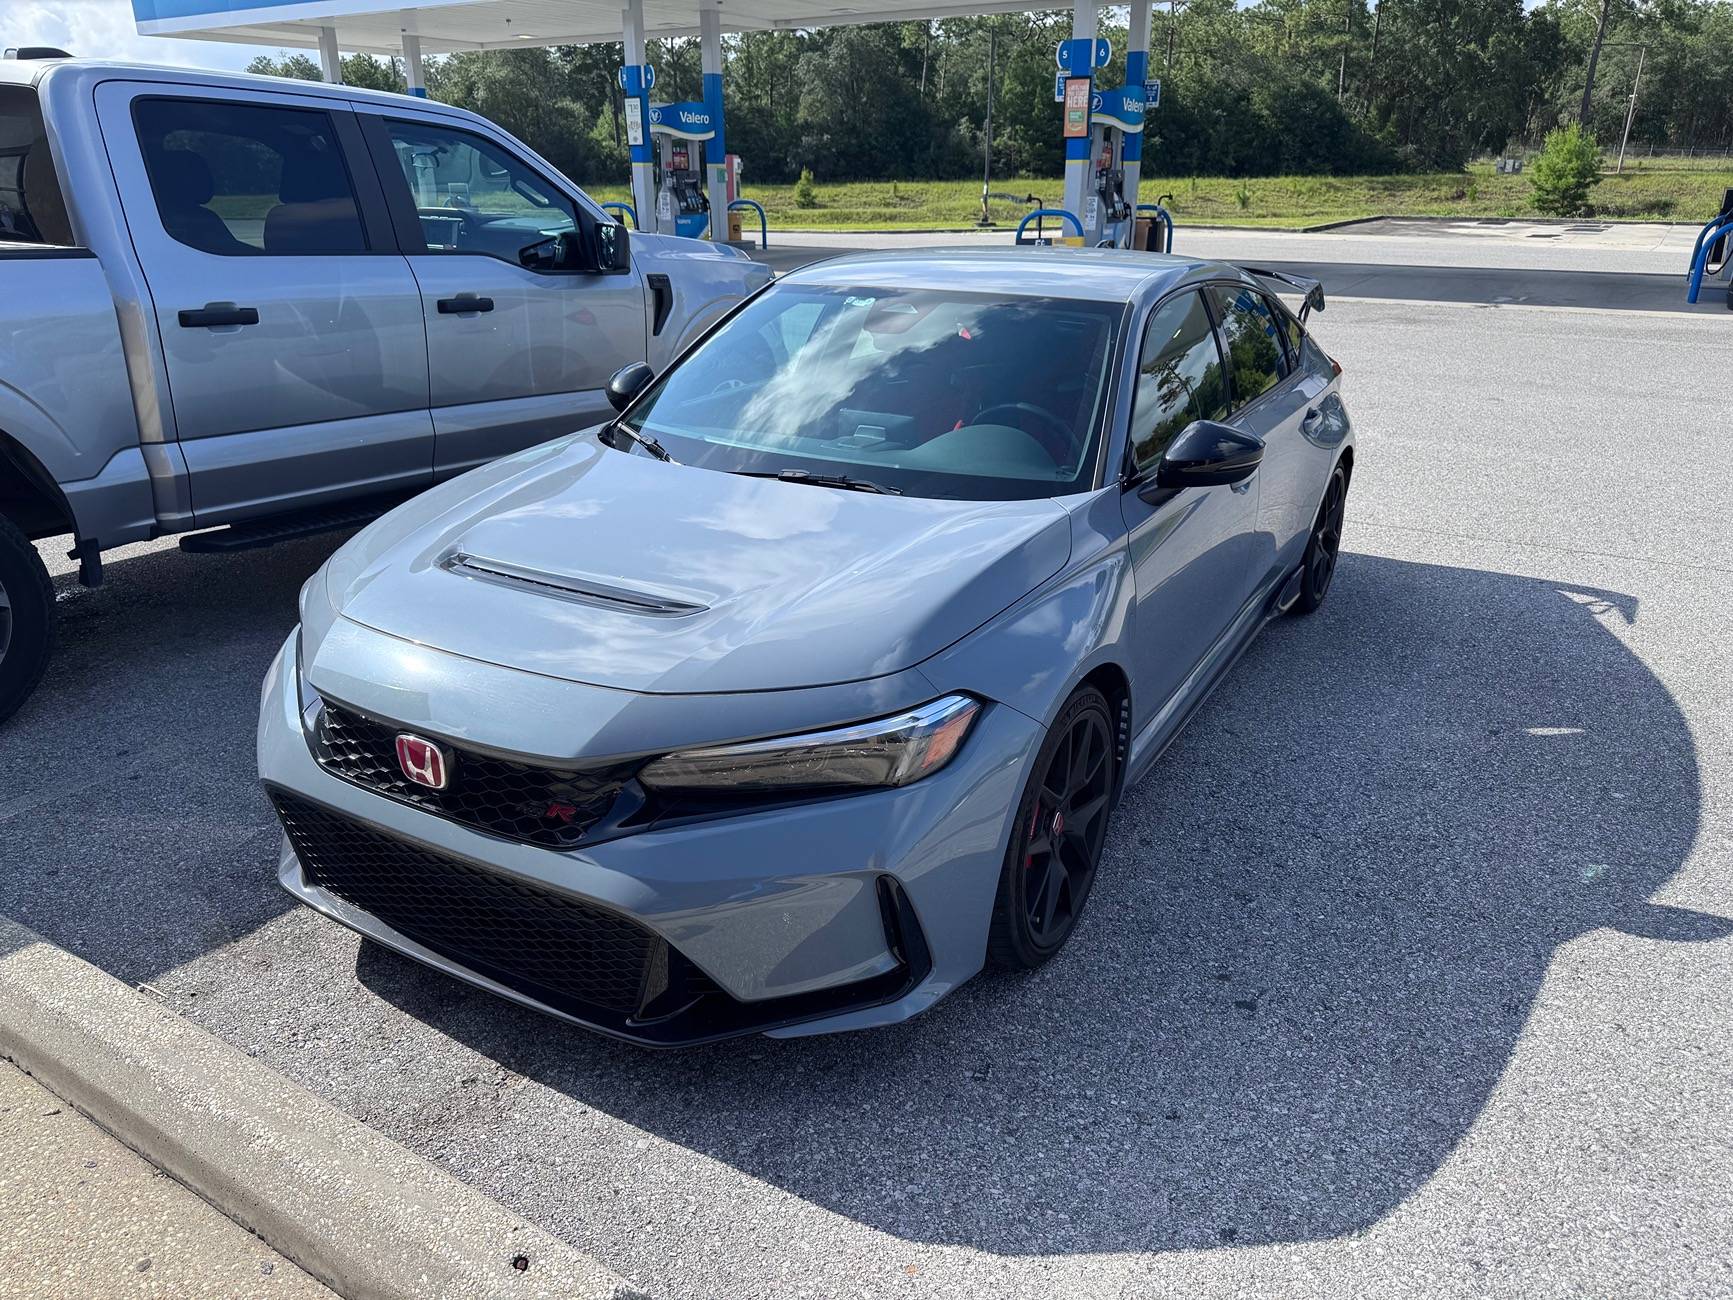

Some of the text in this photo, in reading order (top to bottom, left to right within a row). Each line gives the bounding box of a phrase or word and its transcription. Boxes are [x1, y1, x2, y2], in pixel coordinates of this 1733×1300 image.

[1062, 50, 1068, 58] 5
[1100, 48, 1105, 56] 6
[1067, 95, 1088, 108] HERE
[1123, 96, 1144, 113] Valero
[679, 111, 710, 125] Valero
